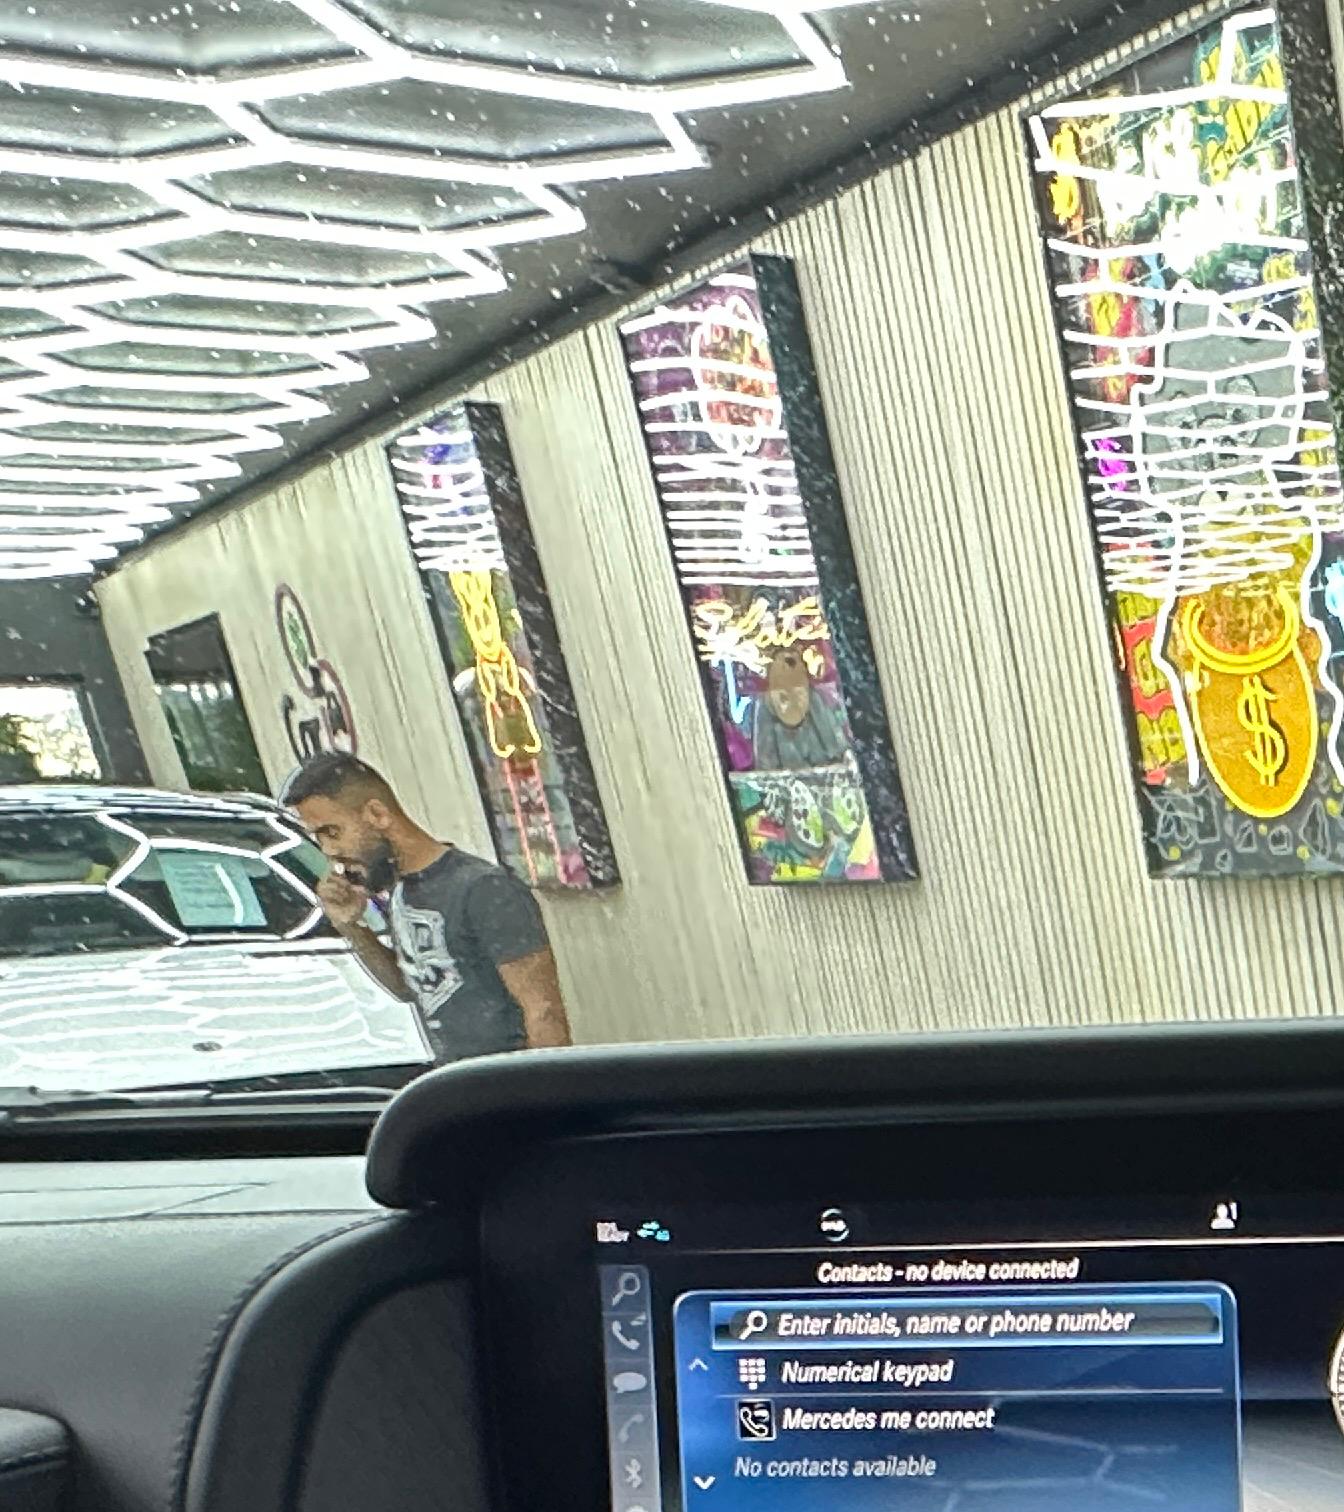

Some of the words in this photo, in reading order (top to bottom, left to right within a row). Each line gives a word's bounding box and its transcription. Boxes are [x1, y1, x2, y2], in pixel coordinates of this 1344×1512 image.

[817, 1261, 892, 1283] Contacts
[905, 1263, 929, 1282] no
[931, 1259, 986, 1281] device
[989, 1256, 1080, 1280] connected
[777, 1313, 831, 1336] Enter
[833, 1312, 900, 1338] initials,
[905, 1313, 961, 1335] name
[964, 1314, 988, 1334] or
[989, 1309, 1053, 1338] phone
[1056, 1307, 1136, 1332] number
[781, 1358, 880, 1384] Numerical
[882, 1358, 955, 1387] keypad
[782, 1407, 878, 1430] Mercedes
[880, 1410, 910, 1430] me
[915, 1407, 996, 1429] connect
[734, 1455, 763, 1478] No
[766, 1456, 848, 1478] contacts
[852, 1454, 937, 1477] available
